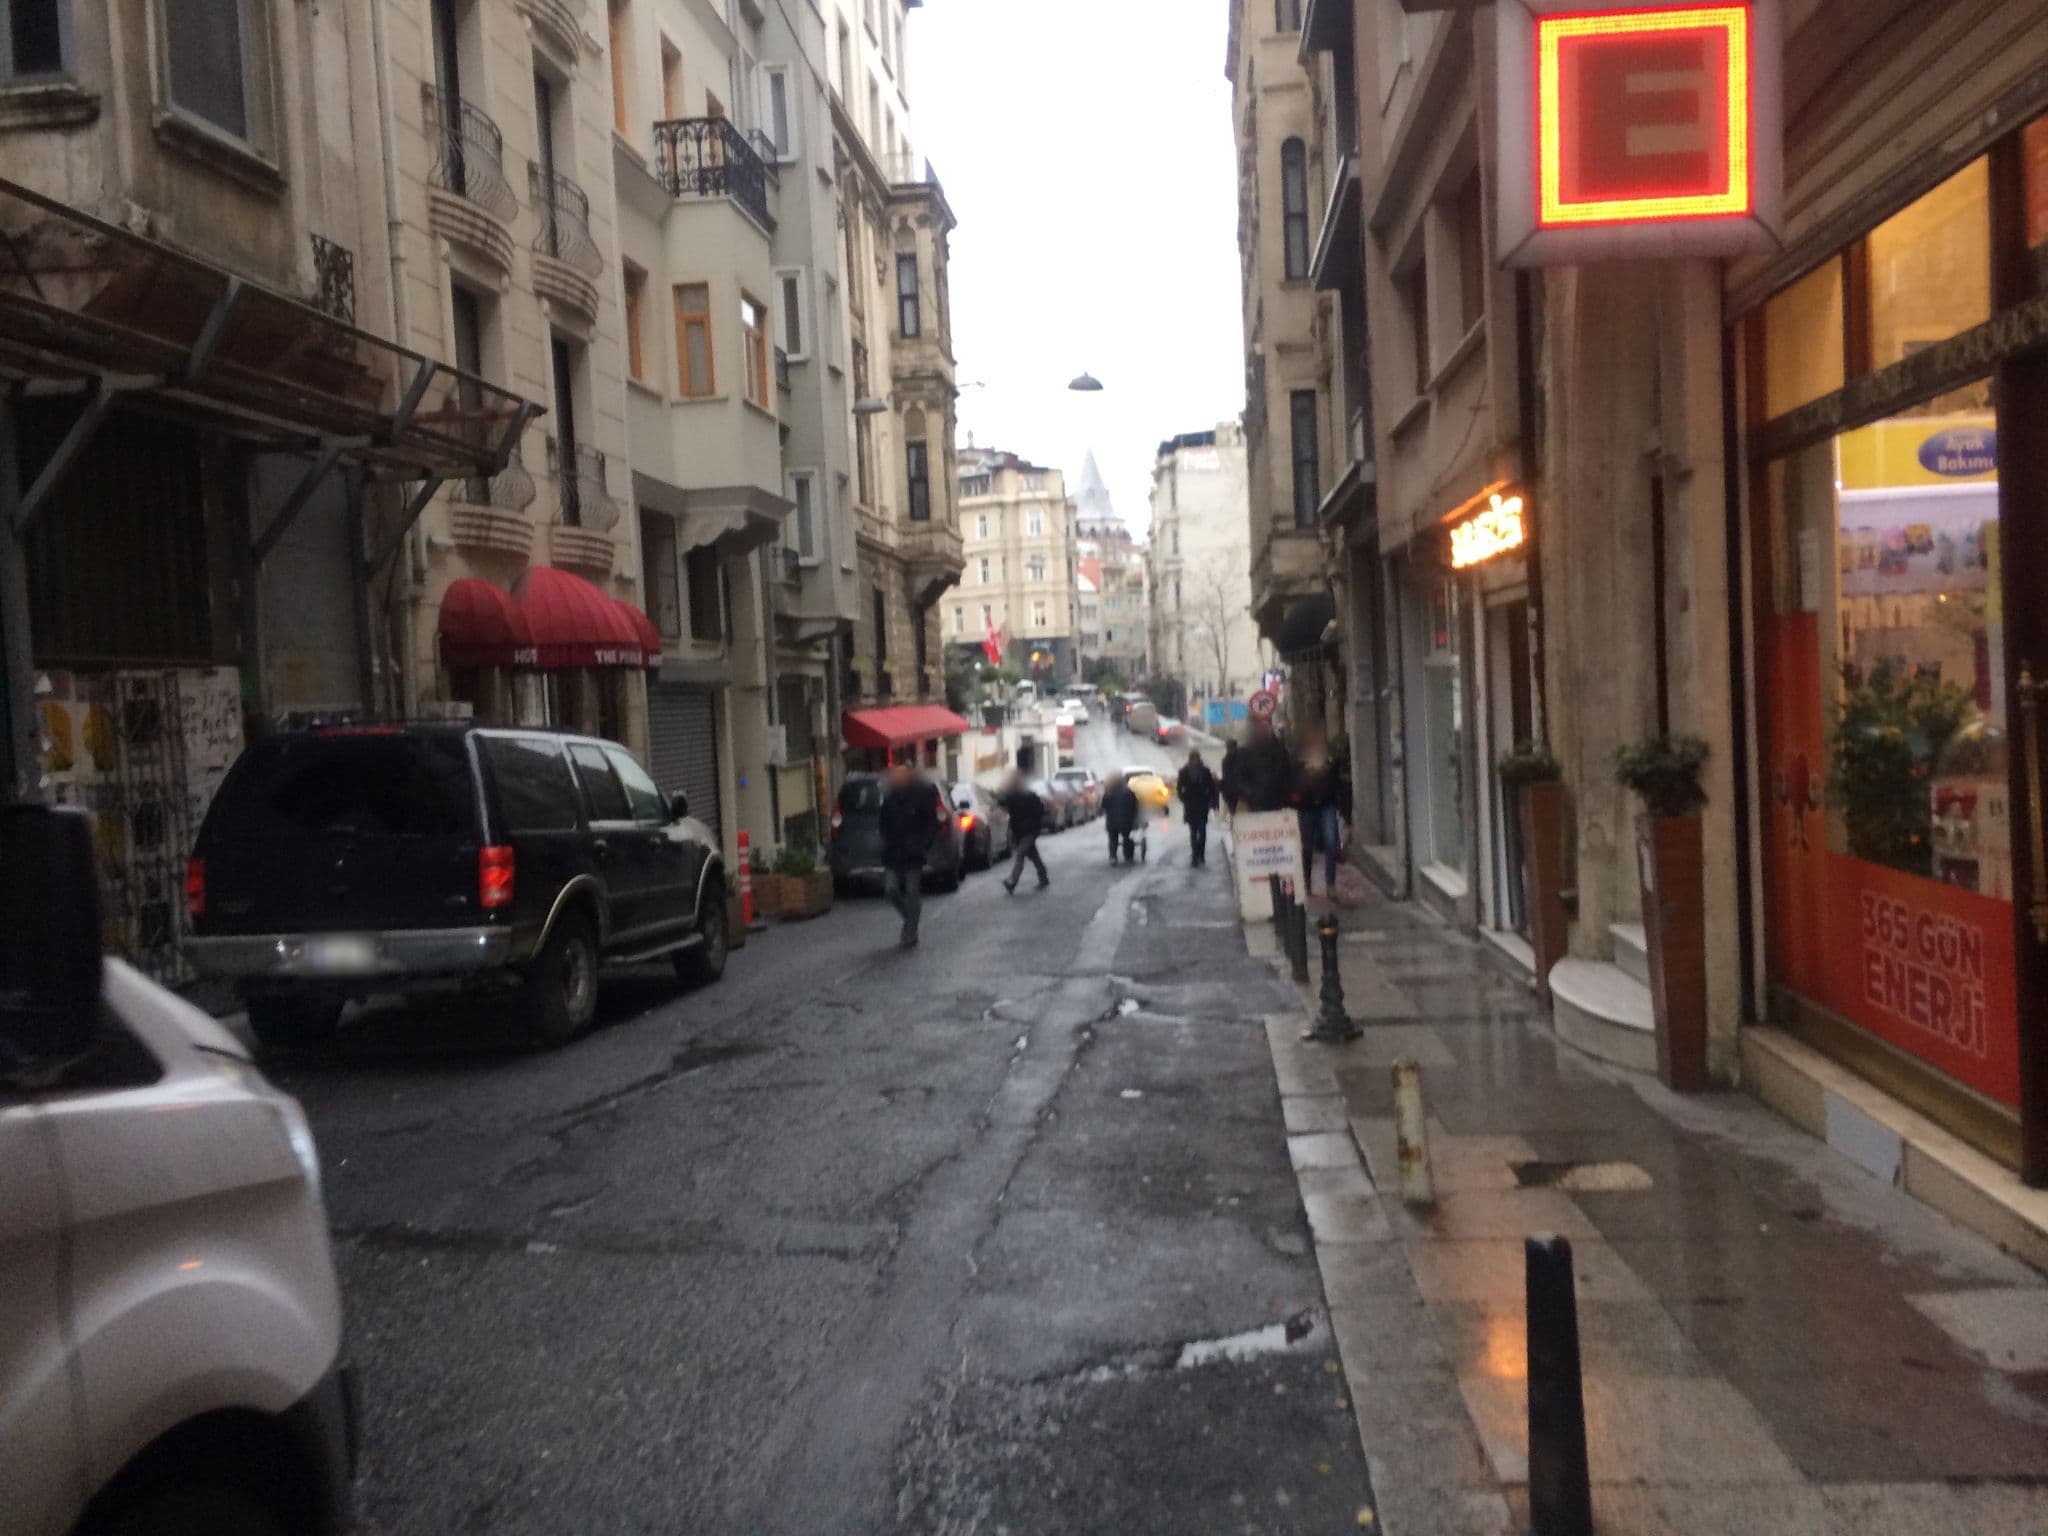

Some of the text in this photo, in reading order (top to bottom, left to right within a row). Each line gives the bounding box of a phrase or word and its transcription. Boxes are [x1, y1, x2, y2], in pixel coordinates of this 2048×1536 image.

[1577, 39, 1711, 197] E
[1861, 889, 1983, 980] 365 GÜN
